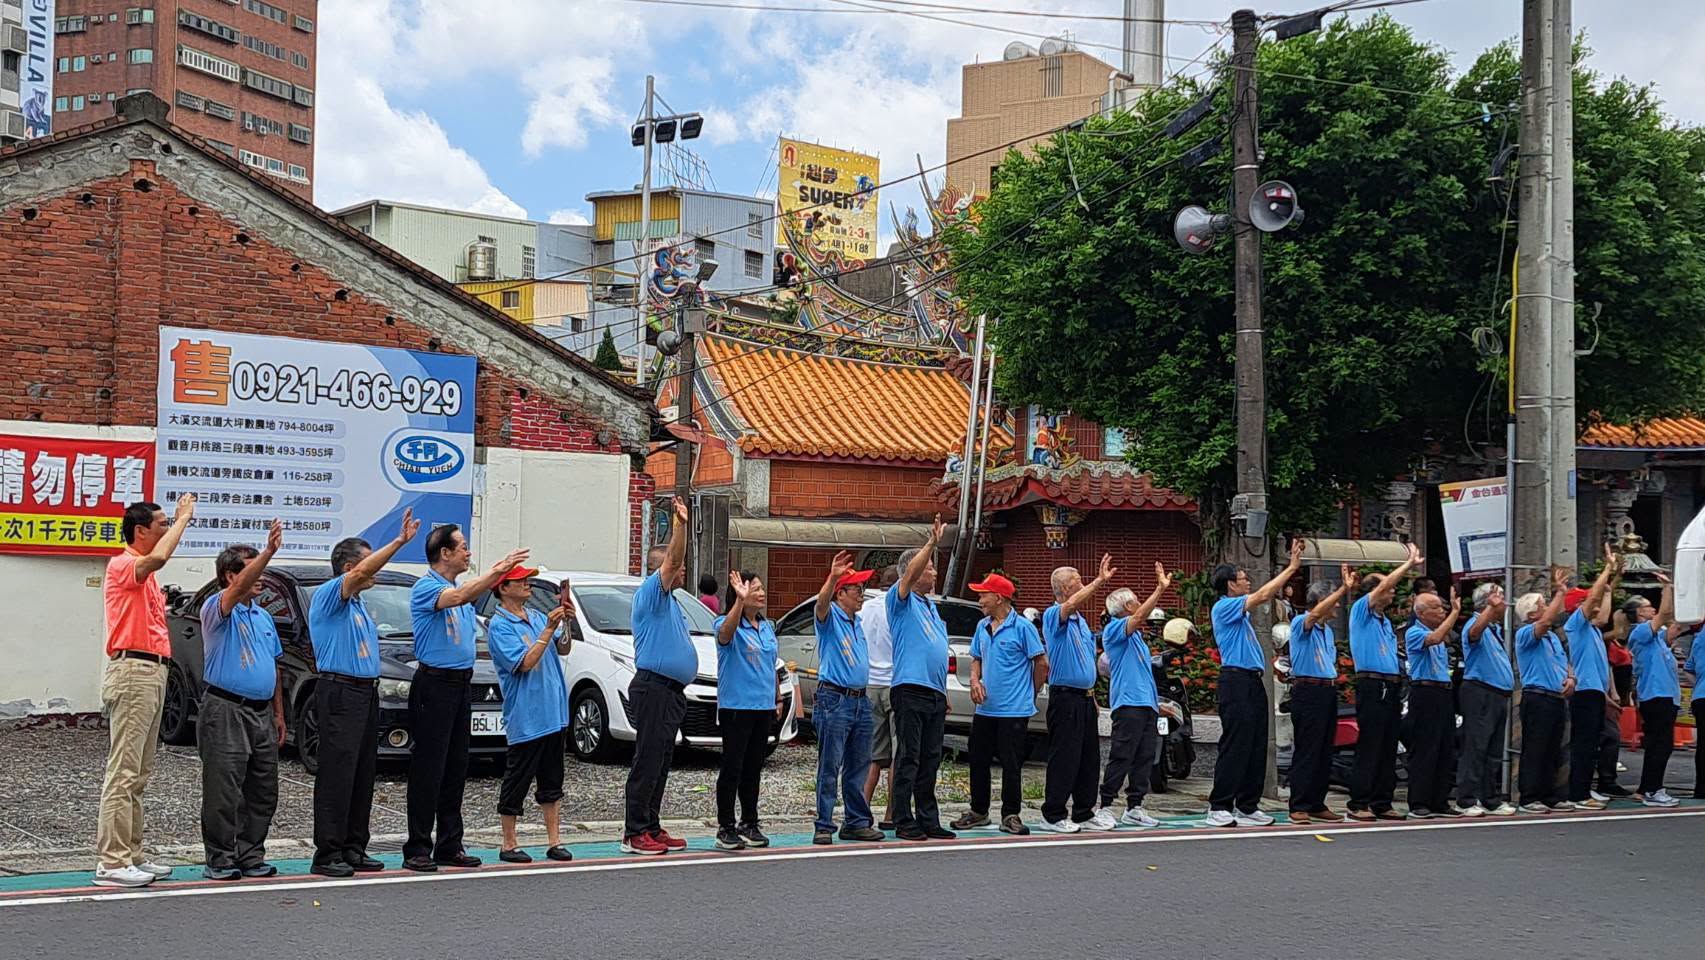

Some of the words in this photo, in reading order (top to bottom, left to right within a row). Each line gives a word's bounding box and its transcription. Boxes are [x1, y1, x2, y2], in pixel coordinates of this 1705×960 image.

[799, 185, 855, 210] SUPER
[170, 338, 232, 406] 售
[233, 361, 462, 417] 0921-466-929
[168, 413, 276, 431] 大溪交流道大坪數農地
[278, 420, 334, 434] 794-8004坪
[276, 445, 333, 458] 493-3595坪
[407, 441, 439, 459] 千月
[393, 459, 421, 473] CHIAN
[0, 449, 146, 508] 請勿停車
[282, 471, 332, 483] 116-258坪
[283, 496, 332, 507] 土地528坪
[0, 518, 126, 544] 次1千元停車
[282, 519, 331, 532] 土地580坪
